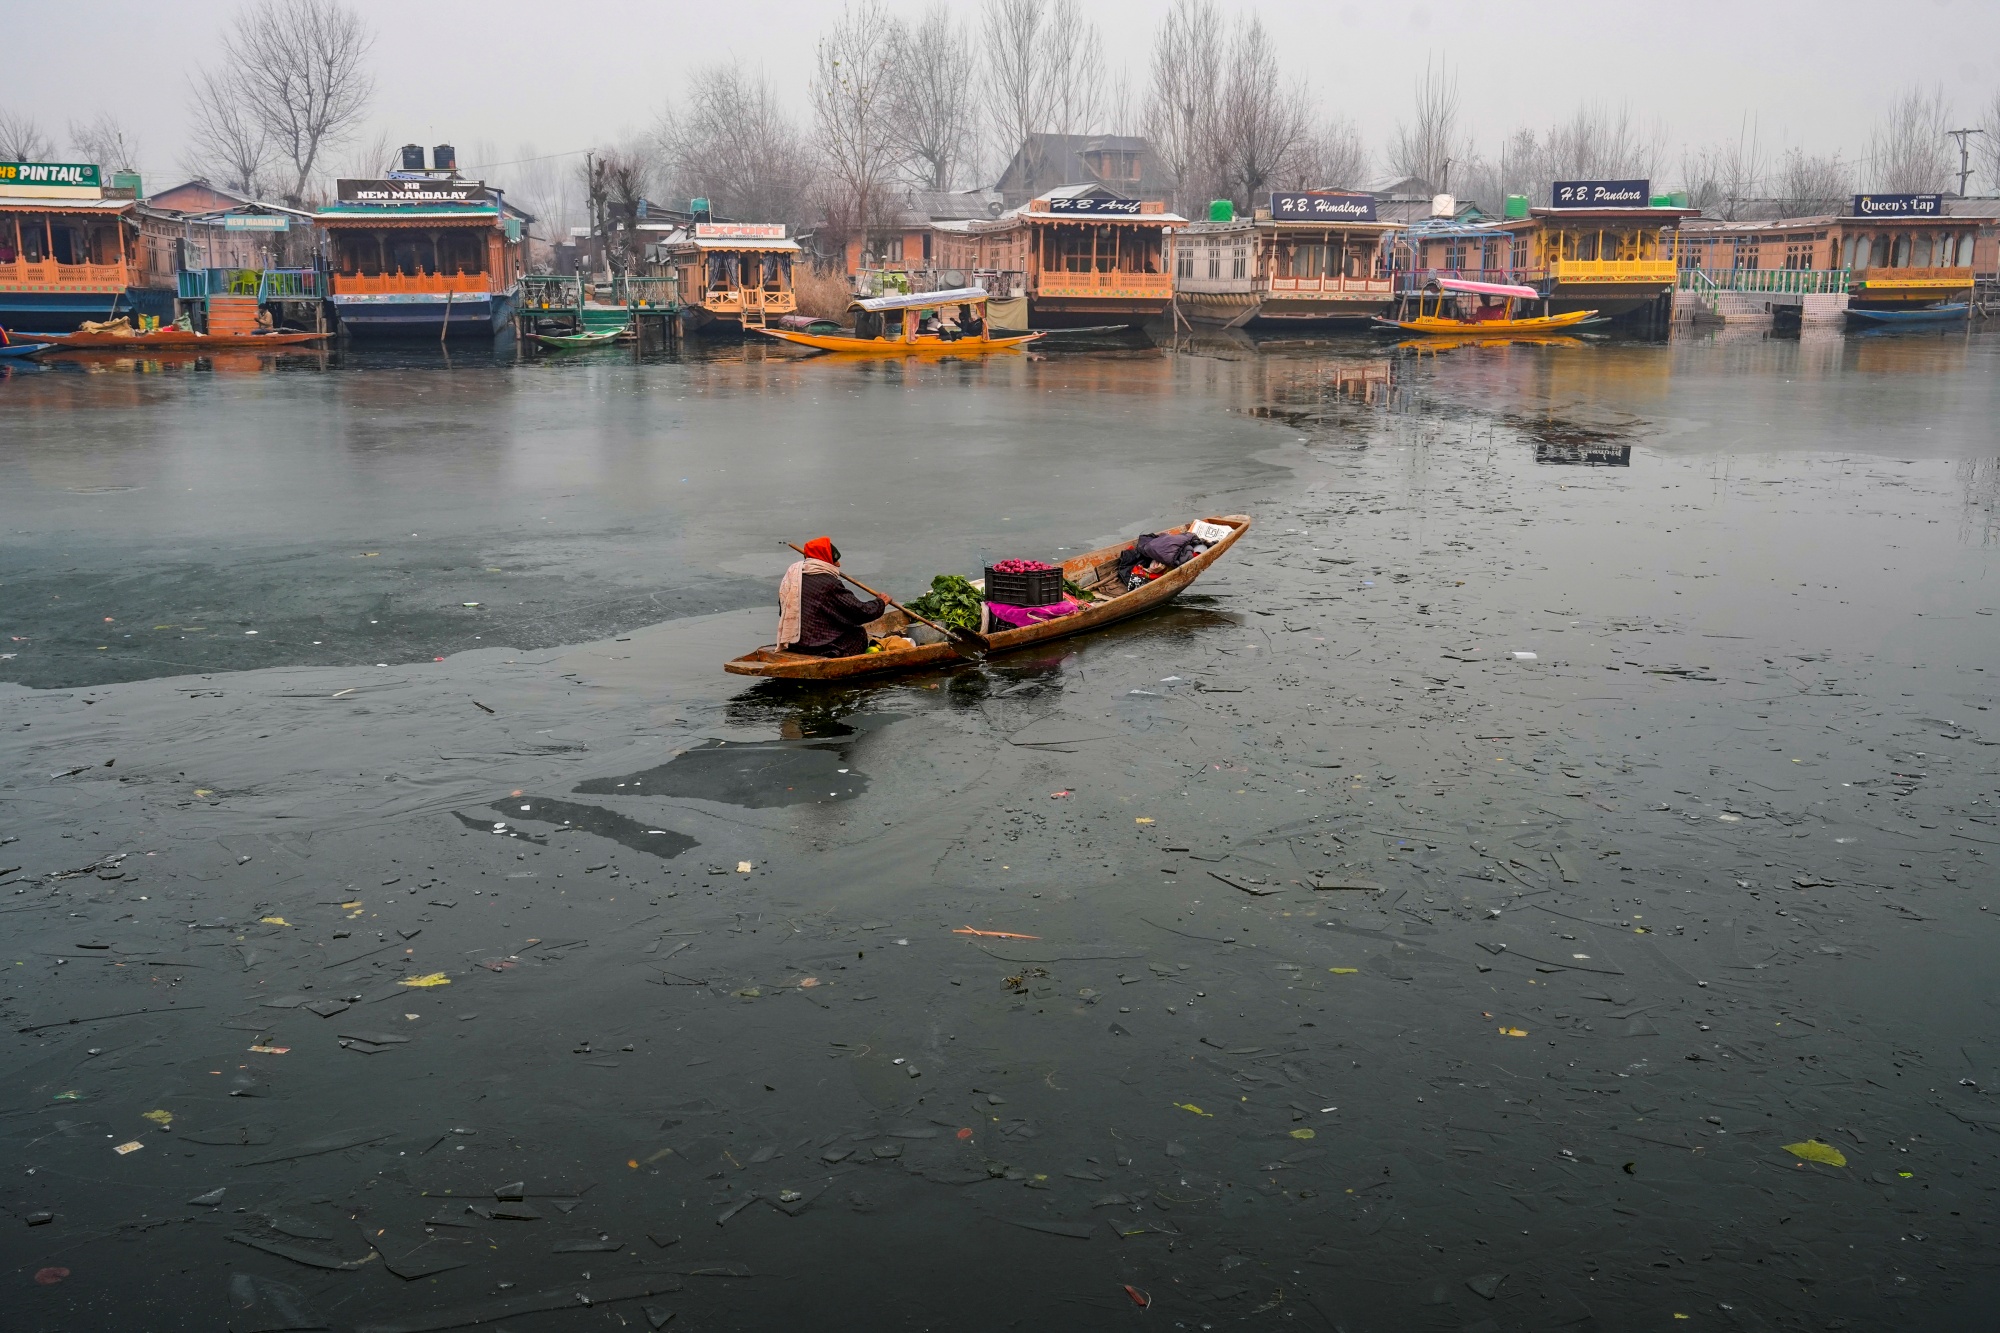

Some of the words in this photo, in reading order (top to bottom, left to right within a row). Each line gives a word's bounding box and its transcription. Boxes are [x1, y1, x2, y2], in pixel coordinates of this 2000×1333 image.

[19, 165, 83, 182] PINTAIL
[357, 191, 389, 199] NEW
[392, 191, 468, 199] MANDALAY
[1560, 186, 1588, 201] H.B.
[1594, 186, 1641, 202] Pandora
[1097, 199, 1141, 213] Arif
[1281, 198, 1310, 212] H.B.
[1314, 198, 1369, 217] Himalaya
[1861, 199, 1907, 214] Queen's
[1910, 198, 1935, 213] Lap
[227, 218, 244, 226] NEW
[245, 218, 286, 227] MANDALAY
[699, 226, 783, 235] EXPORT
